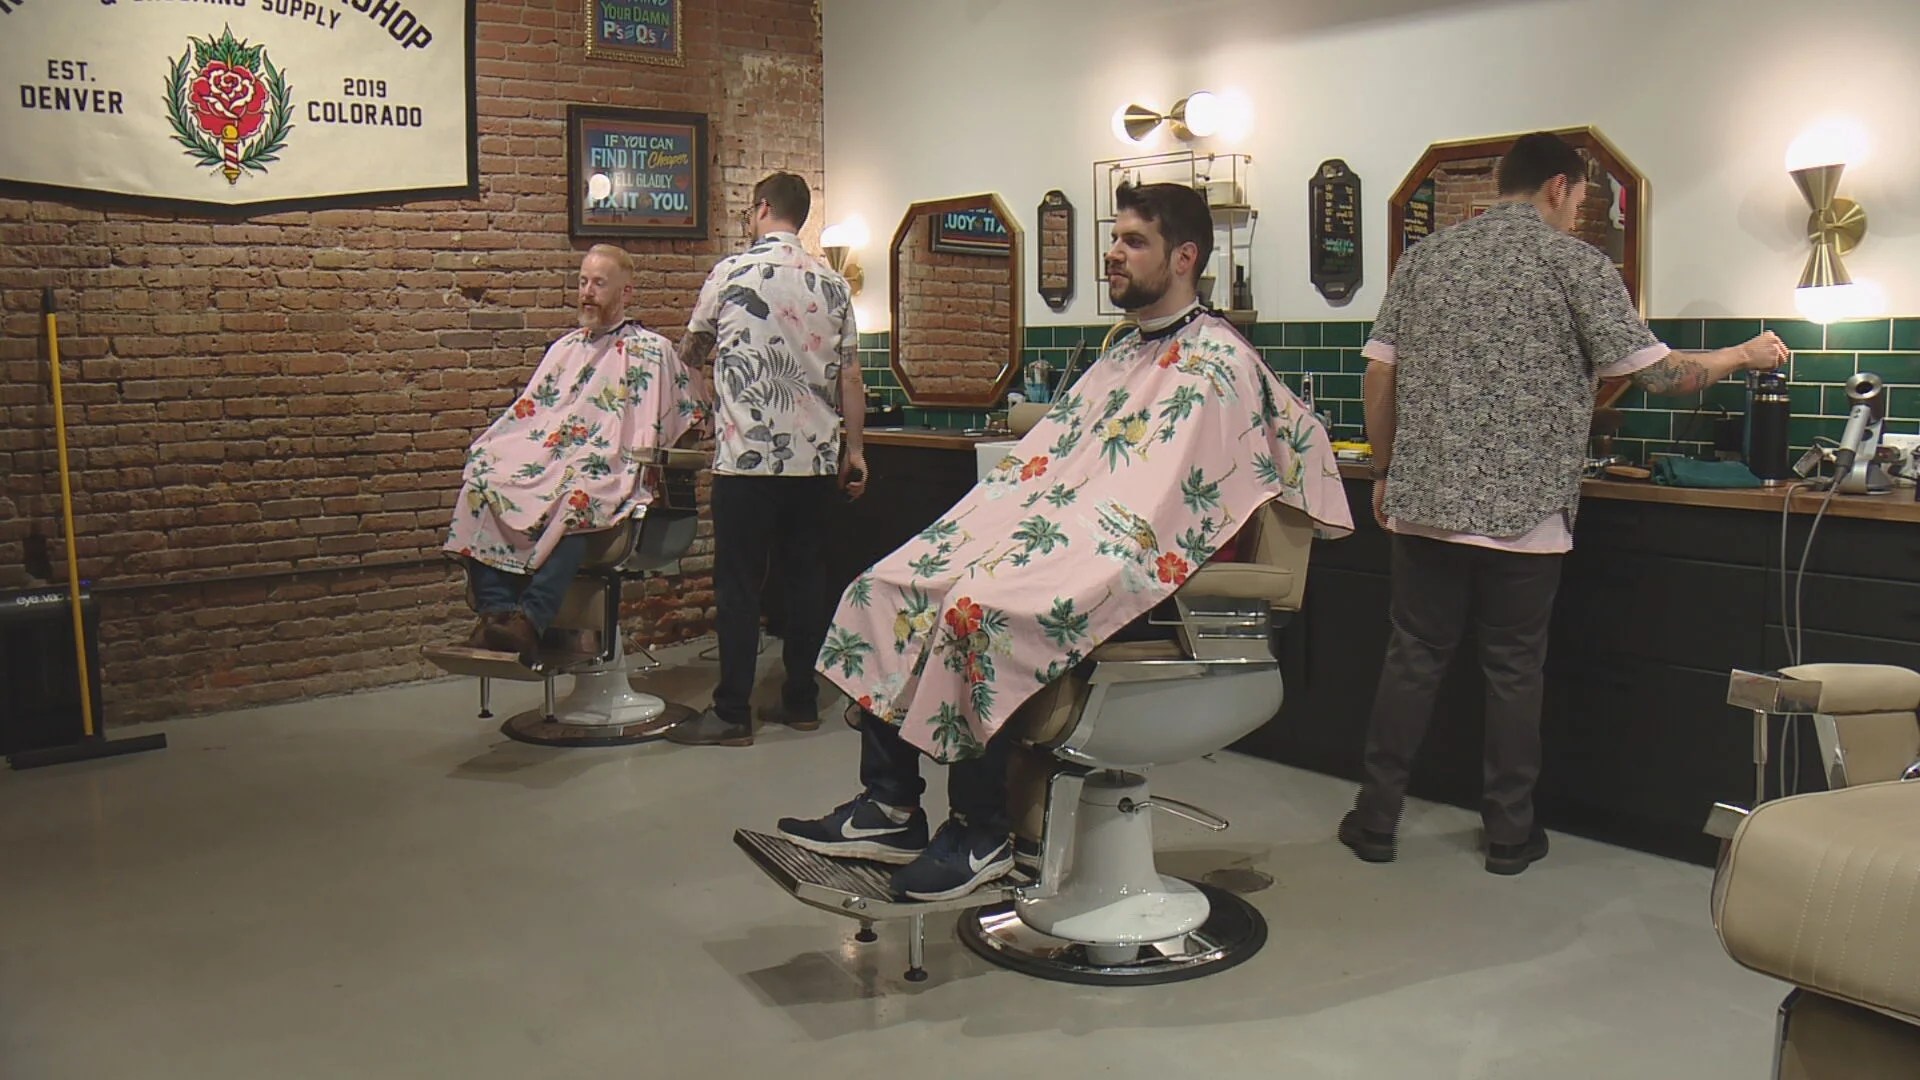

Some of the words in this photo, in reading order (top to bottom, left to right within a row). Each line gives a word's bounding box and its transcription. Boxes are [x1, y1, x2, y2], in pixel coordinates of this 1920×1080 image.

[261, 0, 341, 30] SUPPLY
[601, 2, 633, 20] YOUR
[633, 7, 670, 26] DAMN
[47, 59, 96, 82] EST.
[20, 84, 124, 114] DENVER
[343, 78, 387, 98] 2019
[307, 101, 423, 127] COLORADO
[604, 134, 620, 147] IF
[621, 135, 647, 149] YOU
[649, 137, 675, 151] CAN
[591, 147, 628, 170] FIND
[632, 150, 649, 170] IT
[635, 173, 673, 189] GLADLY
[623, 192, 640, 209] IT
[650, 192, 689, 211] YOU.
